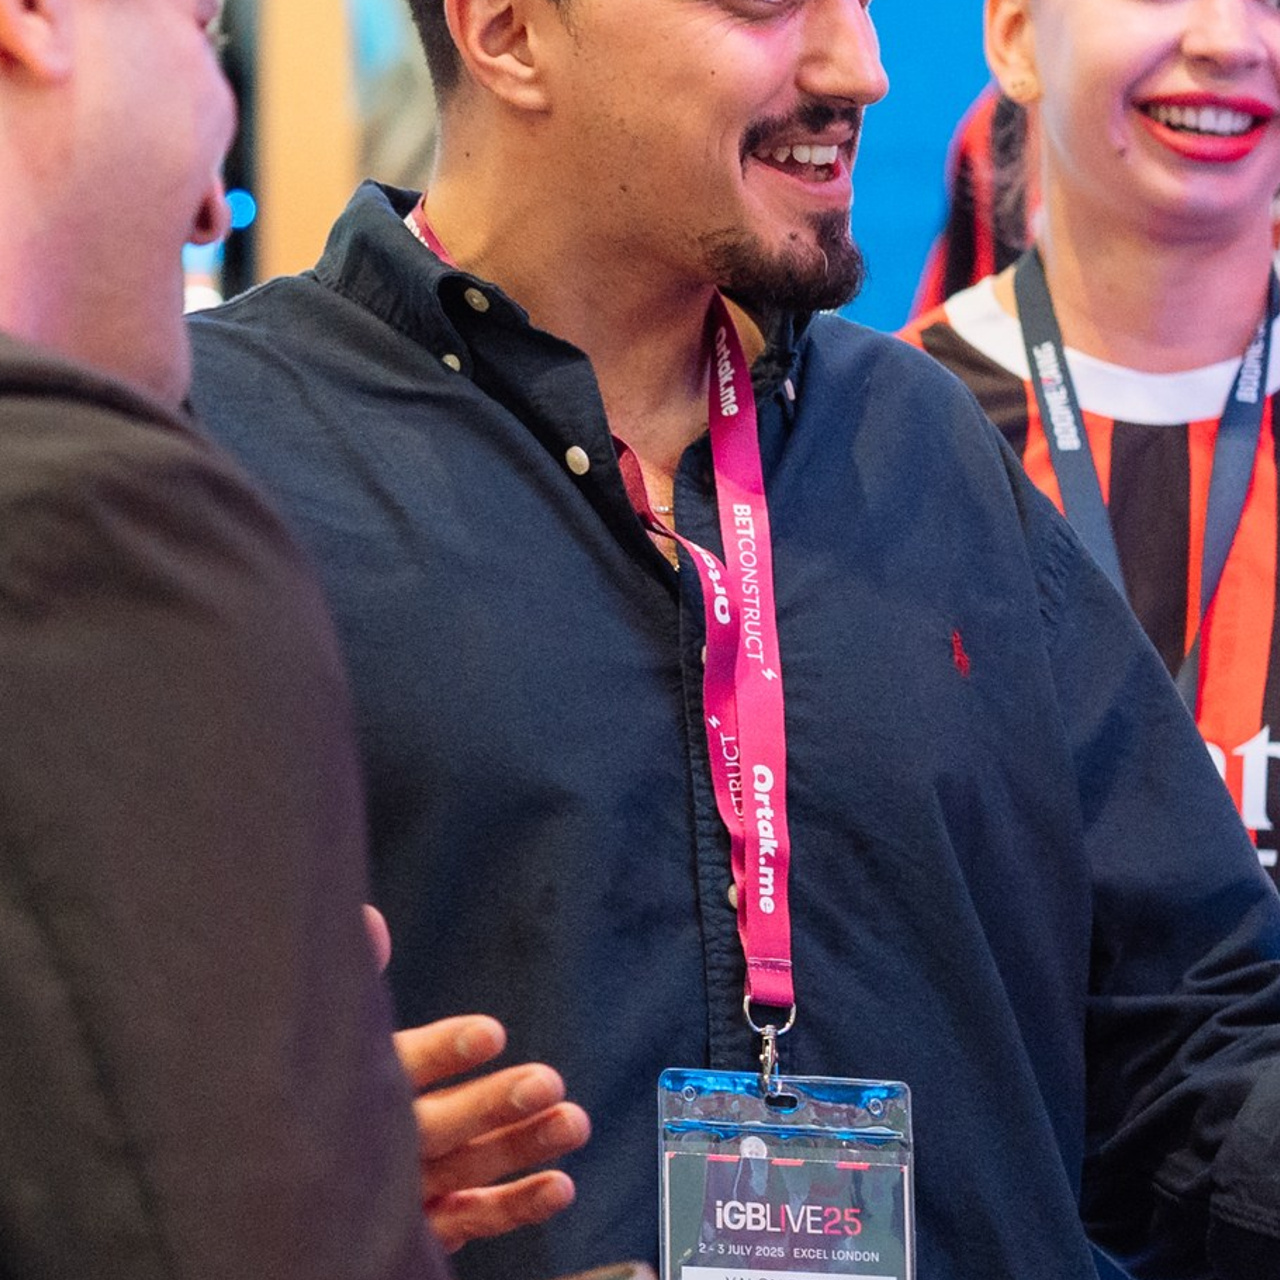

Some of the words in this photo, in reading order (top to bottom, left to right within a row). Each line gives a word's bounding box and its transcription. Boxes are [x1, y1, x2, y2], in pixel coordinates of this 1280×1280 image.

[732, 503, 764, 663] BETCONSTRUCT
[698, 1243, 707, 1253] 2
[717, 1244, 725, 1254] 3
[727, 1244, 752, 1256] JULY
[754, 1245, 785, 1257] 2025
[793, 1248, 828, 1260] EXCEL
[831, 1250, 880, 1263] LONDON
